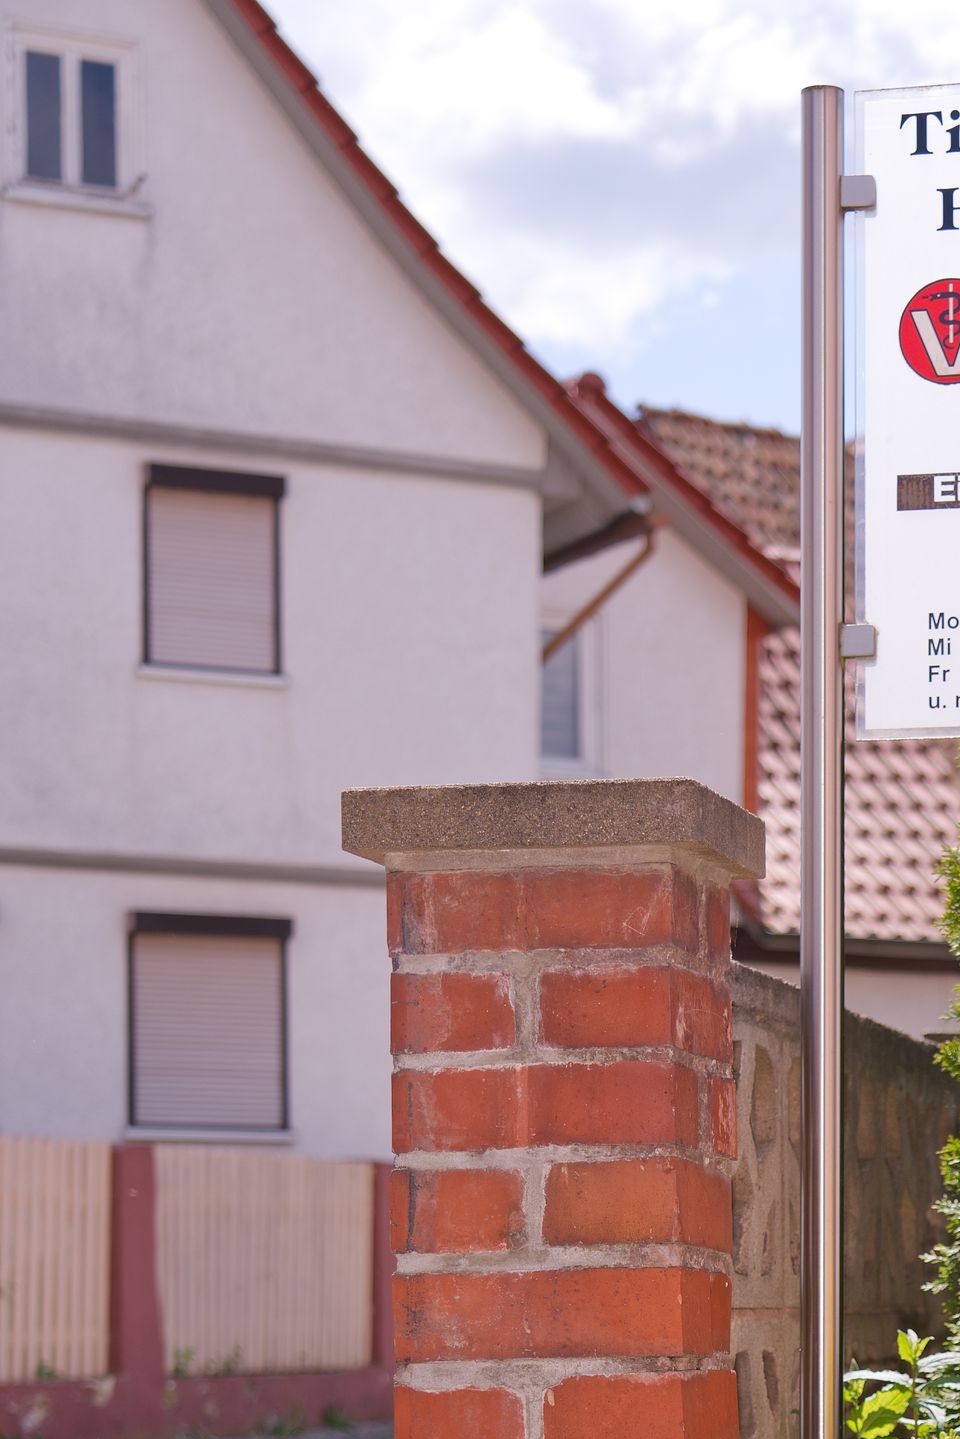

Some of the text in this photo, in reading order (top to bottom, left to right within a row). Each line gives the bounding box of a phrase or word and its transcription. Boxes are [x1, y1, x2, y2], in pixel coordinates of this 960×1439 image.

[928, 612, 960, 630] Mo
[927, 637, 951, 656] Mi
[928, 664, 951, 683] Fr
[928, 696, 947, 709] u.
